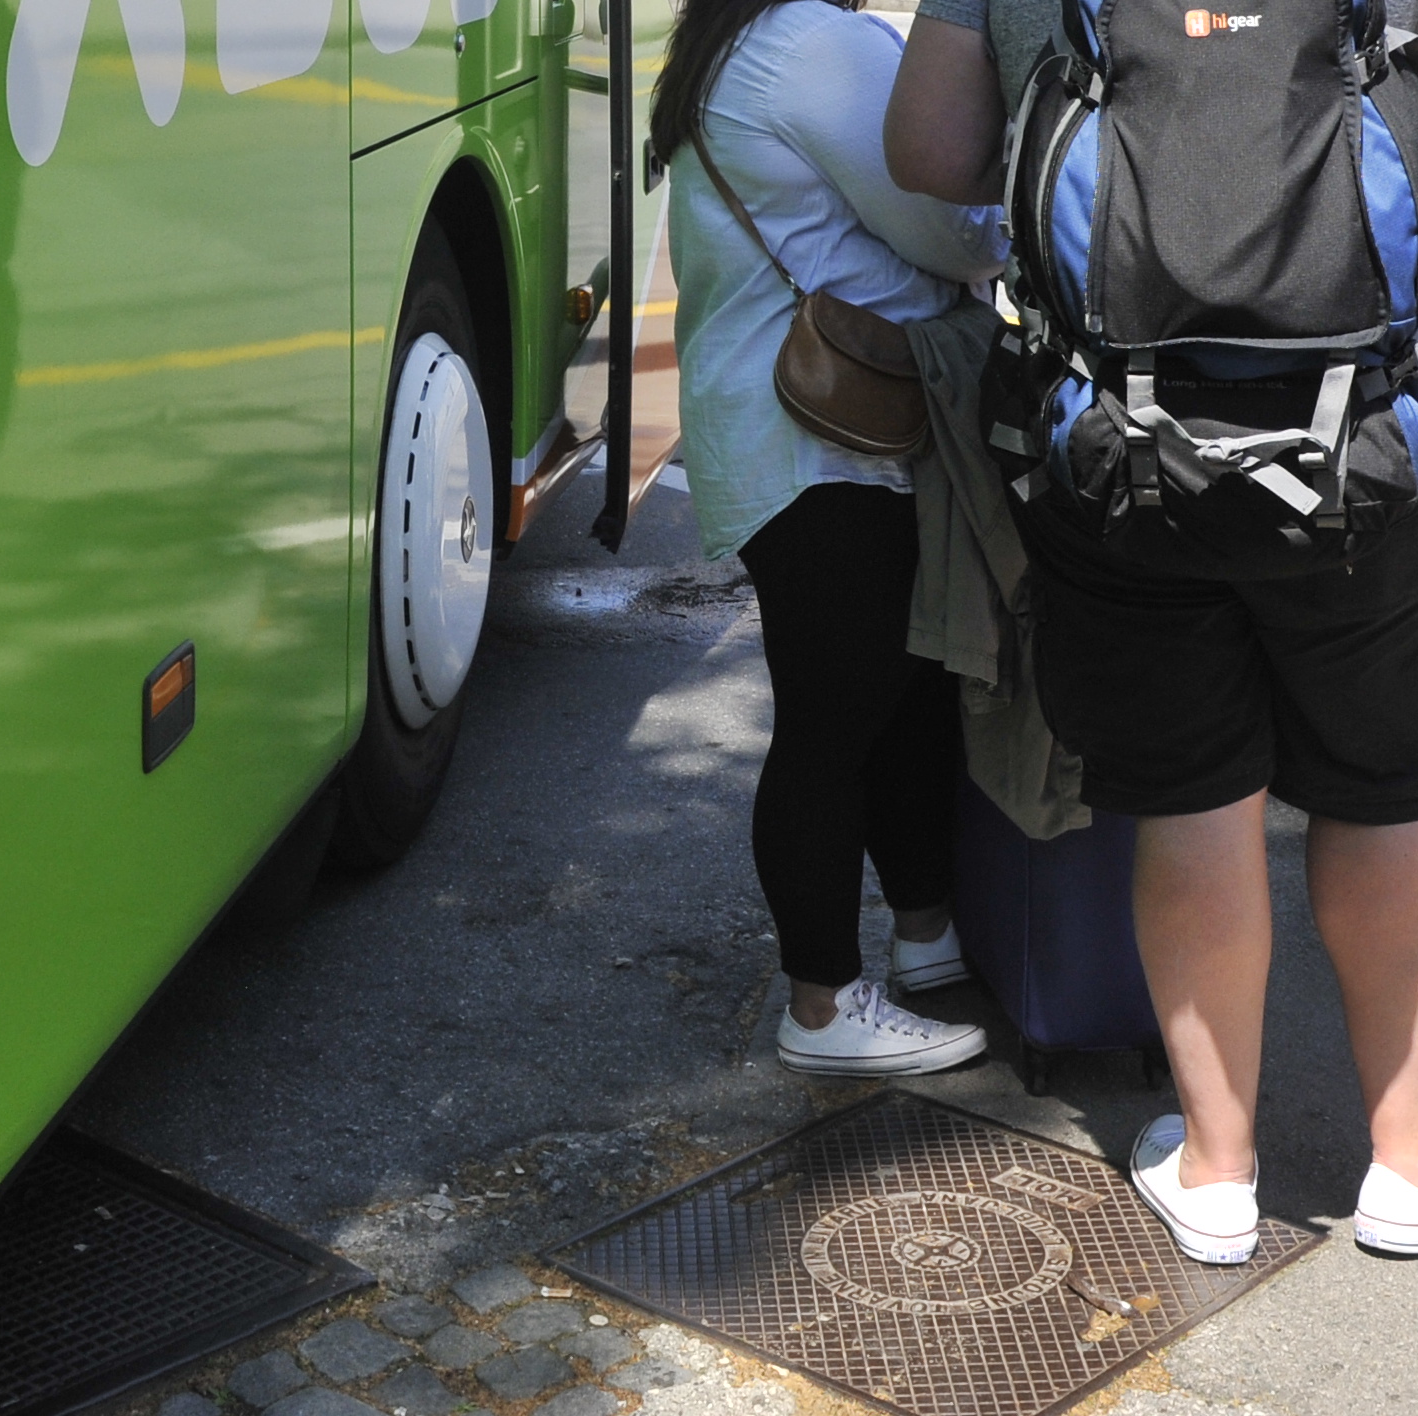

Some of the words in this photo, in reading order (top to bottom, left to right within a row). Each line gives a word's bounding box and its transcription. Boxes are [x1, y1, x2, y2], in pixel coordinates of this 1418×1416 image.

[1212, 13, 1262, 32] higear
[921, 1192, 1065, 1246] LJUBLJANA
[821, 1272, 949, 1314] TOVARNE
[969, 1257, 1069, 1312] STROJNE
